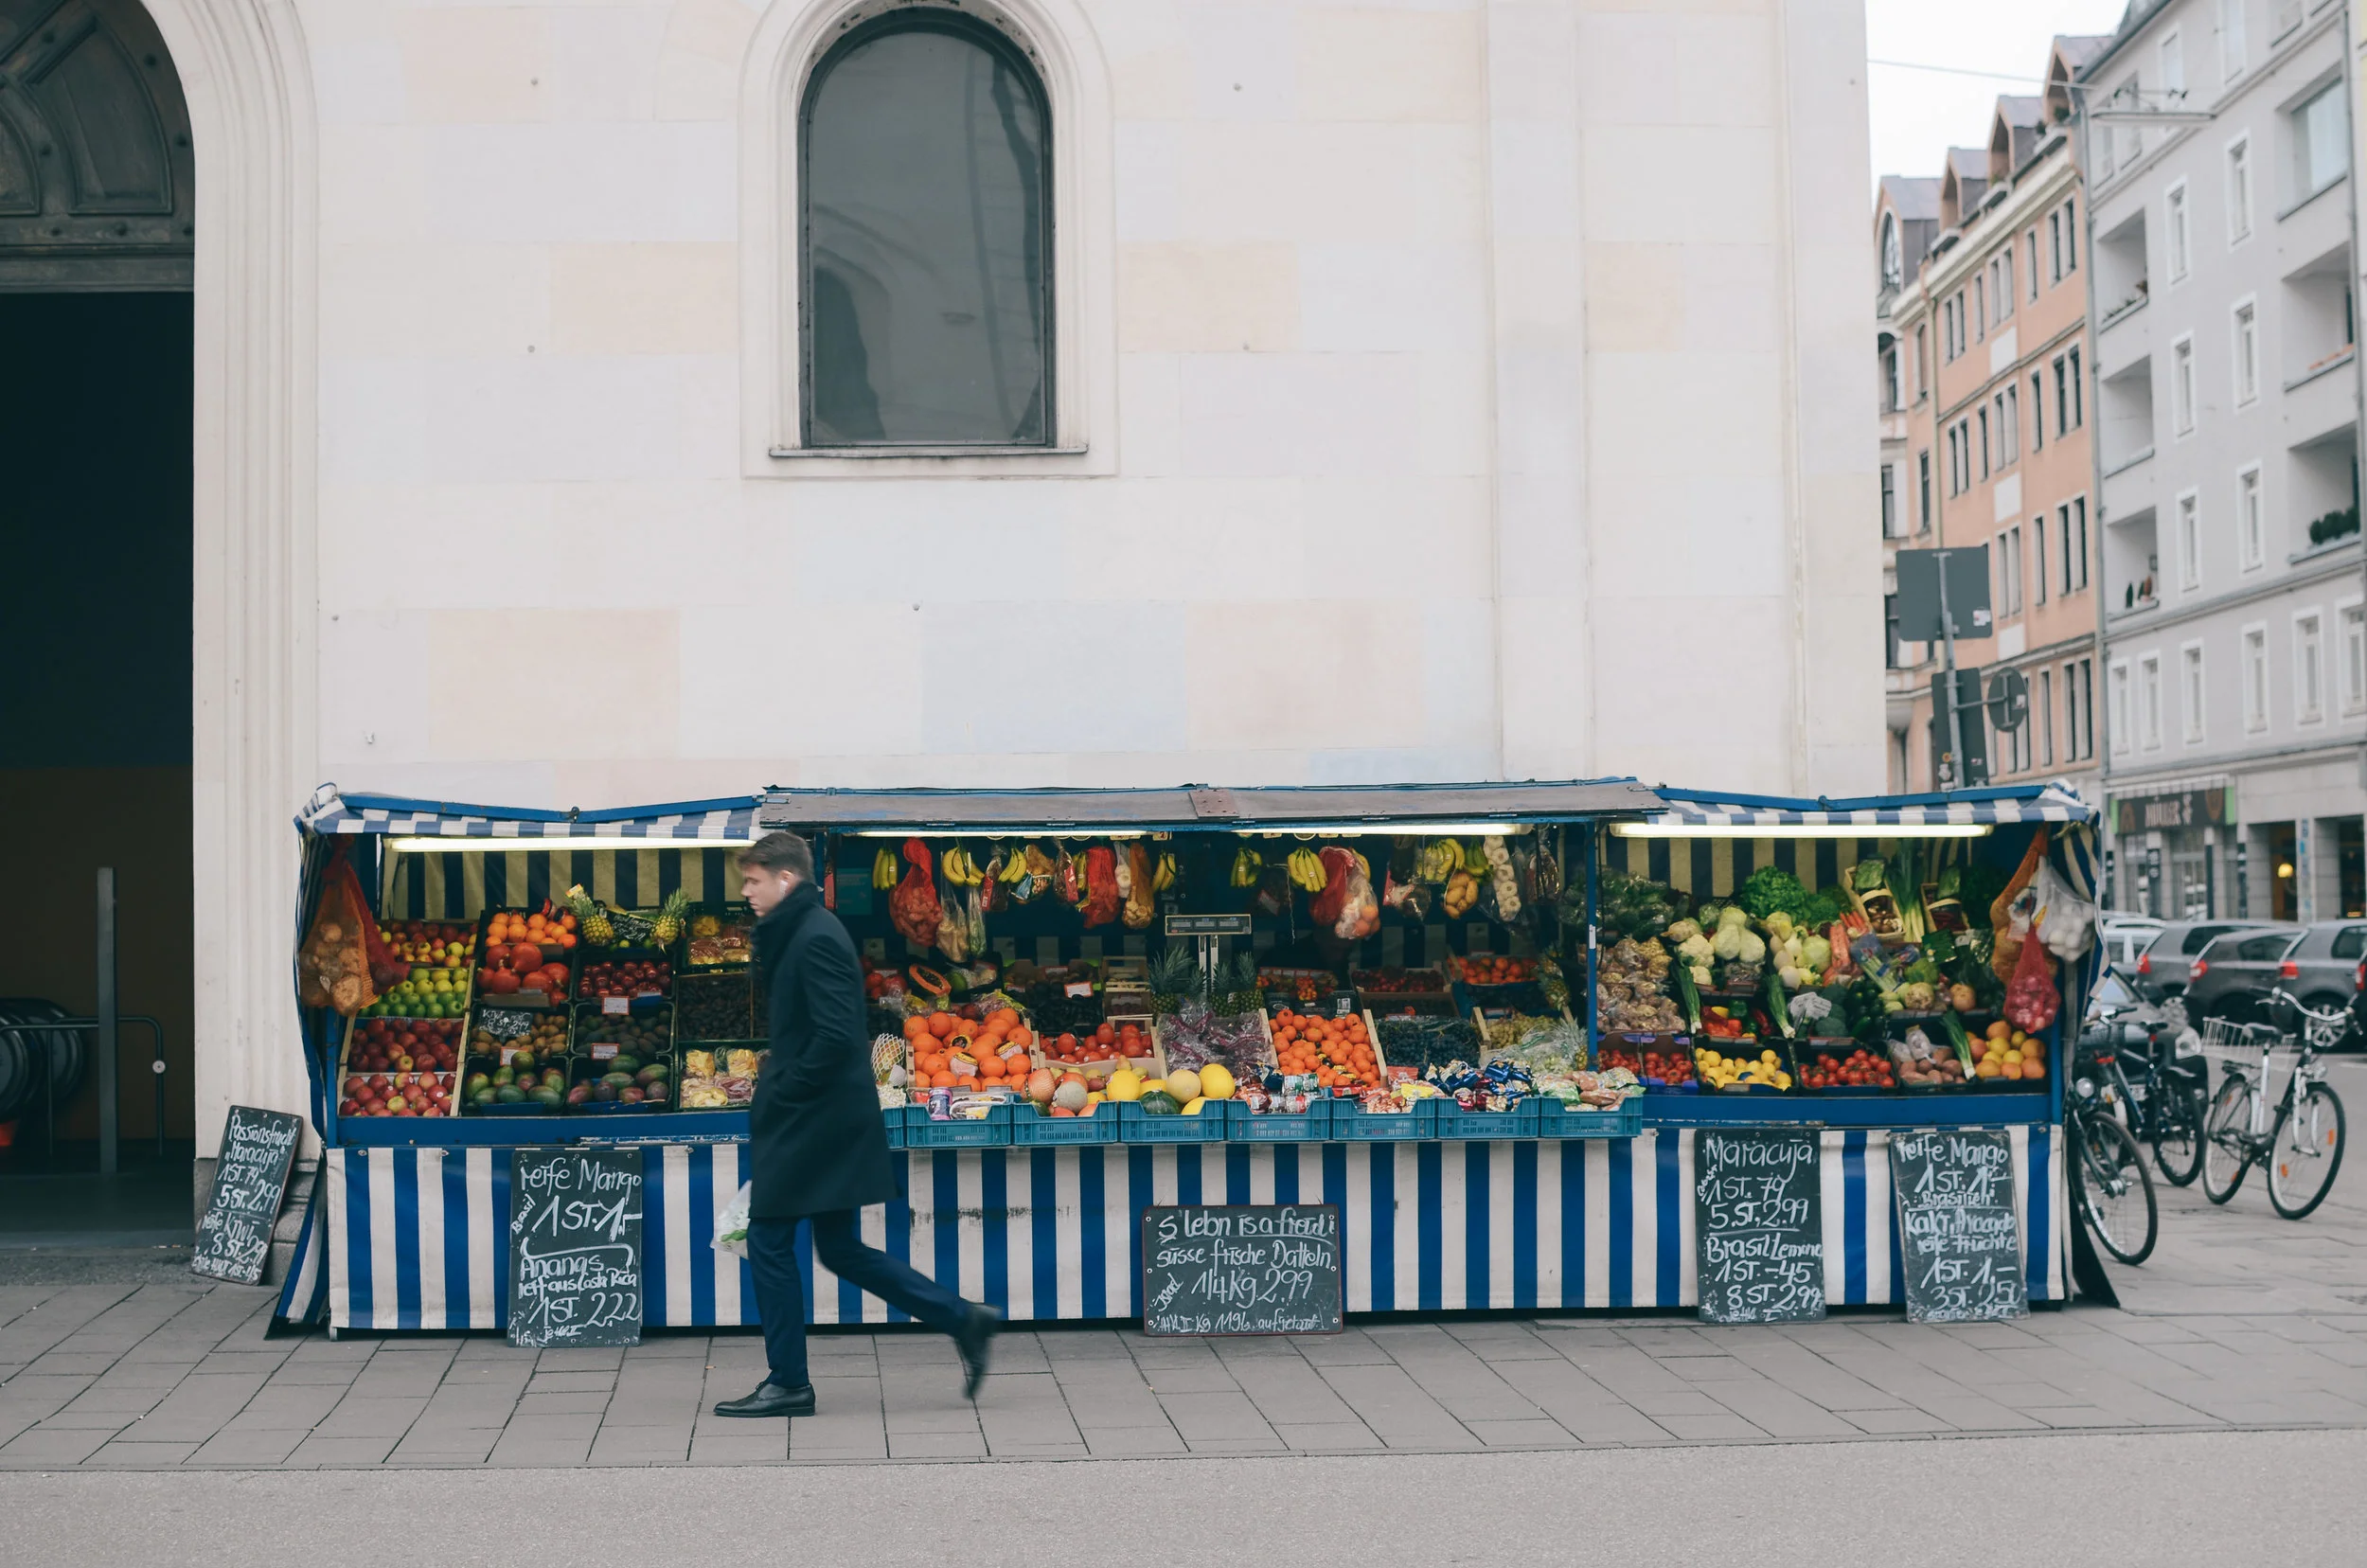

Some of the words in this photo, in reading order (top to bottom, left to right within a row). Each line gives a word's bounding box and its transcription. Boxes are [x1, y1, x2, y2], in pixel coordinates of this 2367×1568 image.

[1705, 1135, 1813, 1184] Maracuja
[1949, 1137, 2009, 1168] Mango
[520, 1157, 572, 1196] reife
[578, 1158, 643, 1204] Mango
[1259, 1217, 1273, 1235] a
[1762, 1199, 1809, 1228] 2.99
[1271, 1239, 1331, 1269] Datteln
[1706, 1234, 1770, 1263] Brasil
[520, 1254, 605, 1280] Ananas
[1257, 1268, 1314, 1303] 2.99
